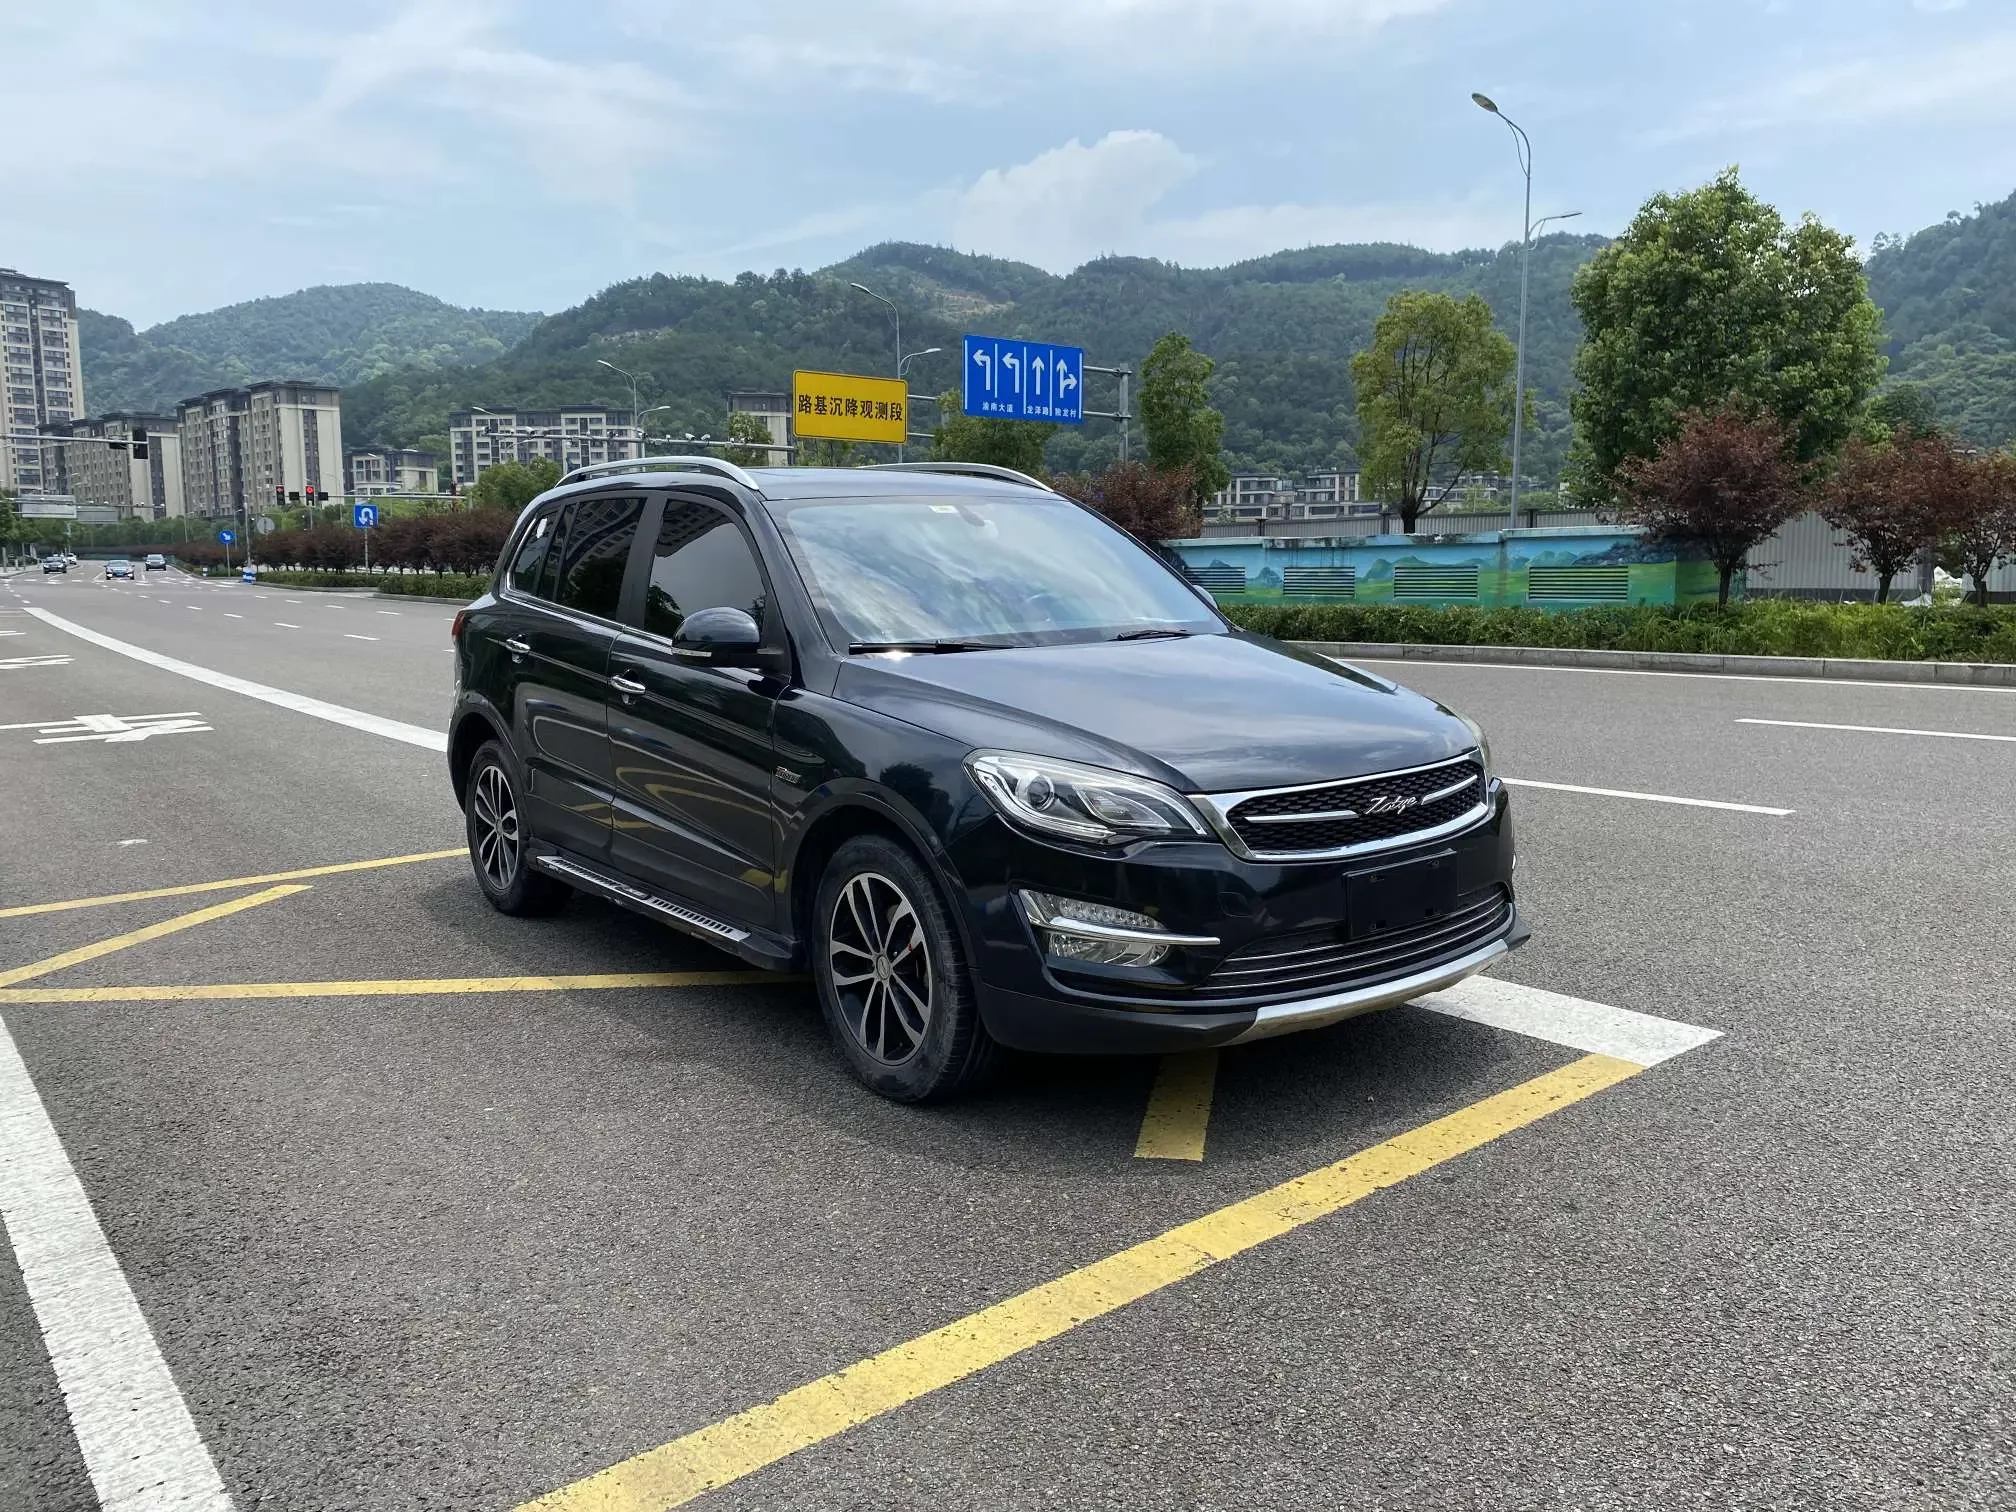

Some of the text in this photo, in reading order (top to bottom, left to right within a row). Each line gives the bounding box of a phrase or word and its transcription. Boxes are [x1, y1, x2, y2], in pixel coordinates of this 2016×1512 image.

[798, 394, 903, 421] 路基沉降观测段
